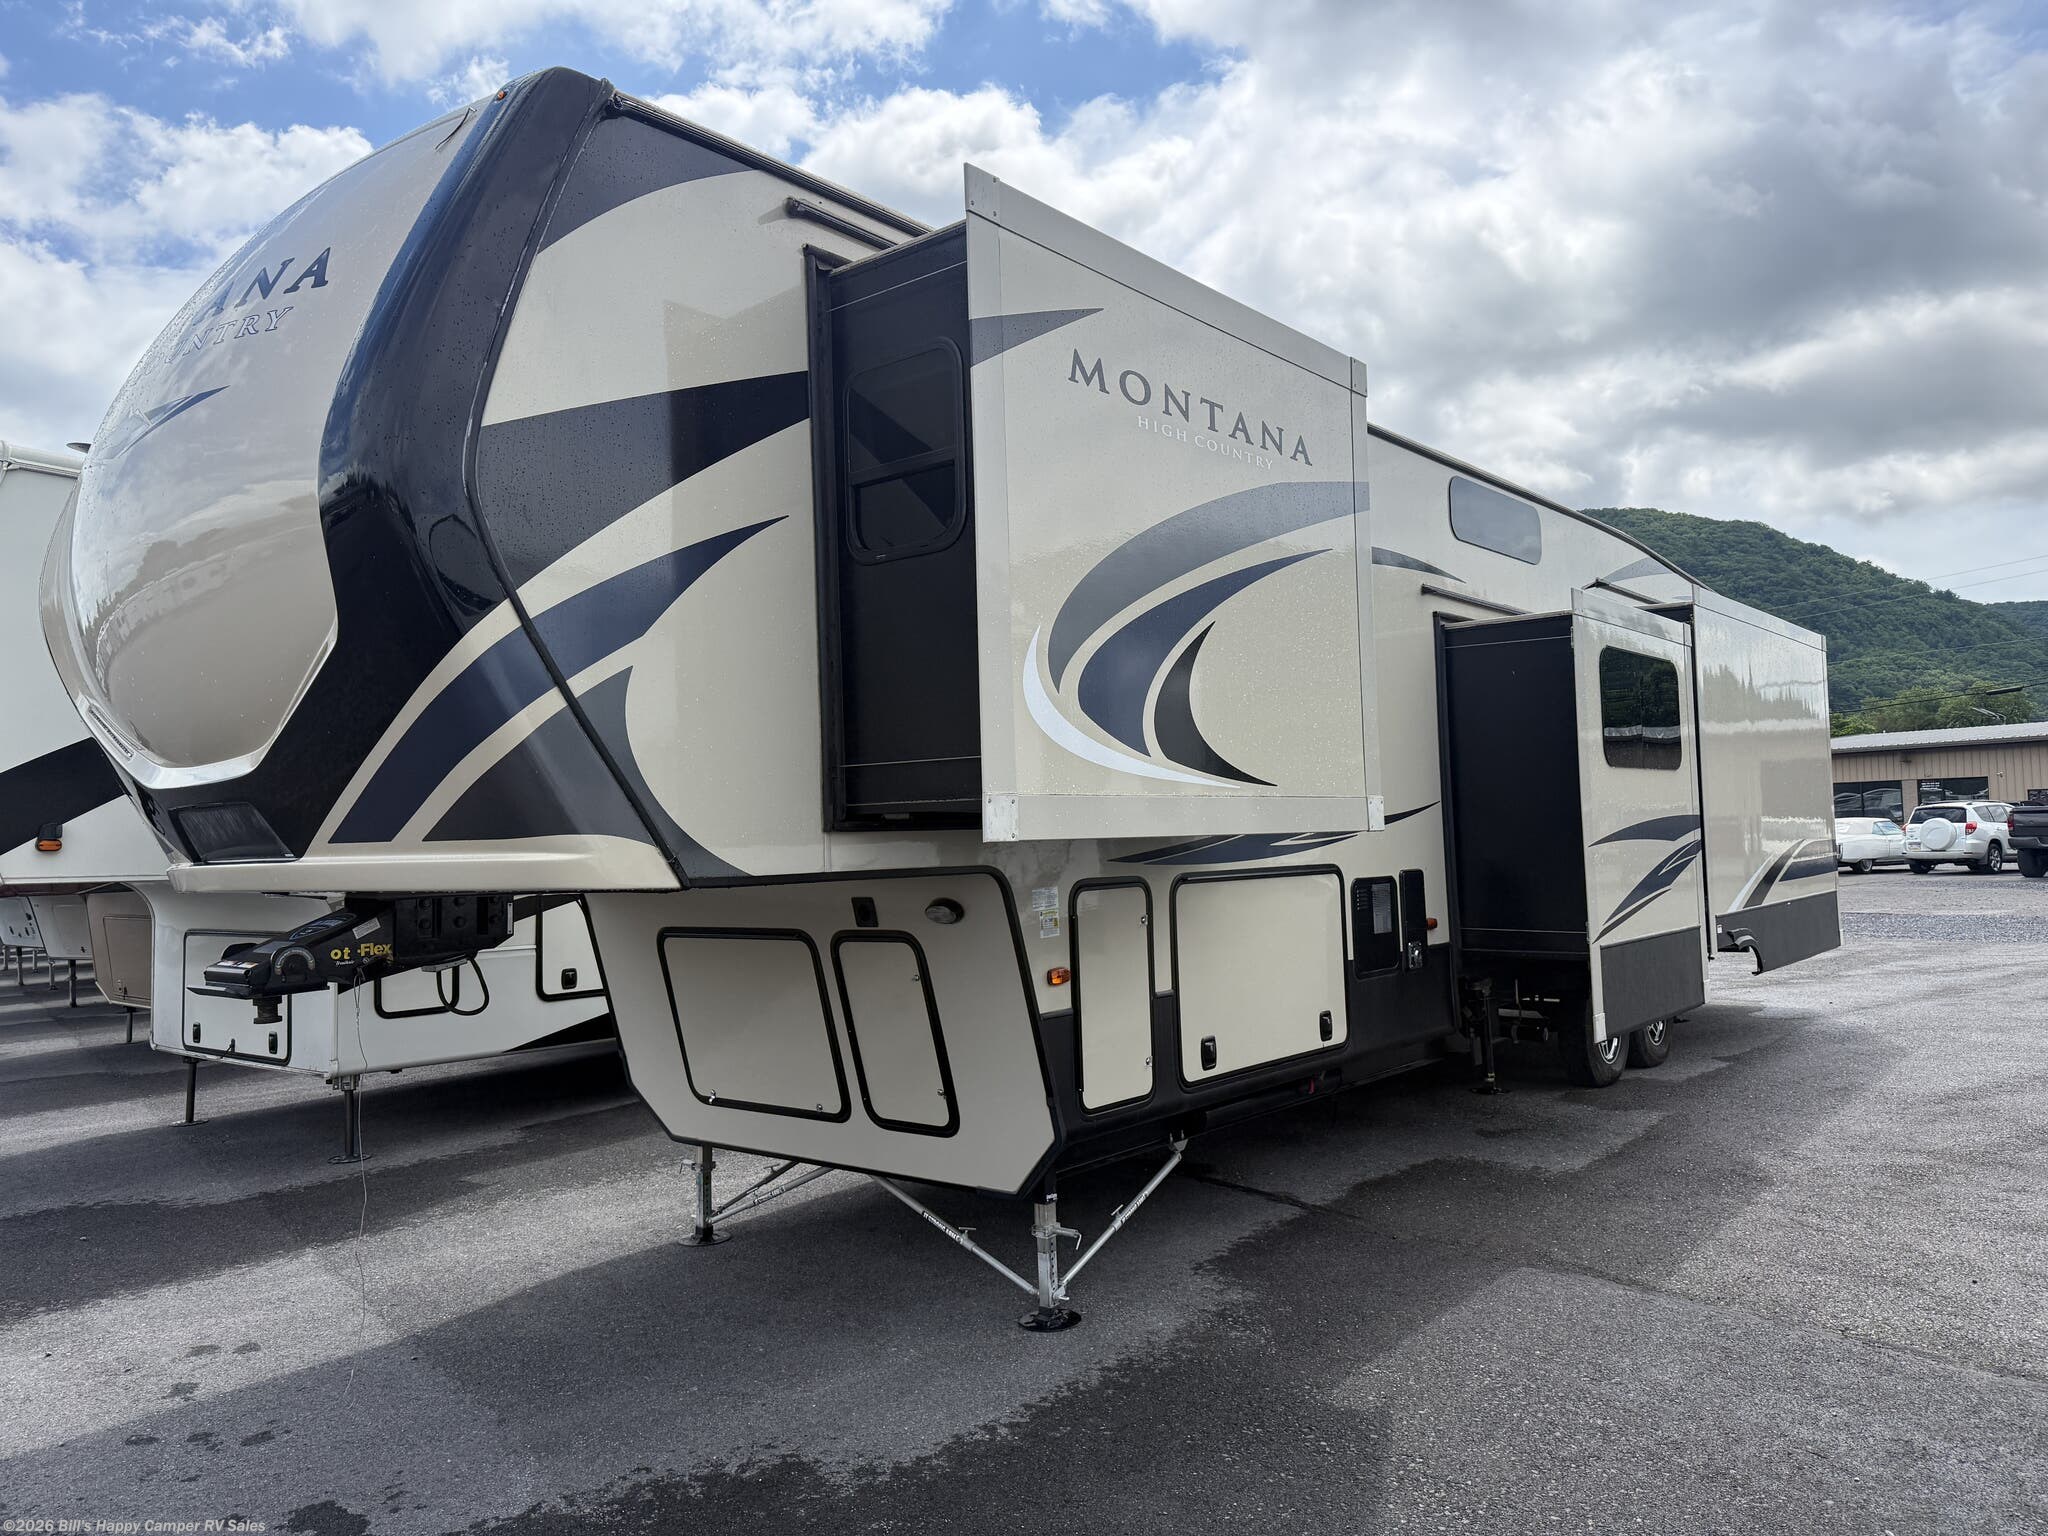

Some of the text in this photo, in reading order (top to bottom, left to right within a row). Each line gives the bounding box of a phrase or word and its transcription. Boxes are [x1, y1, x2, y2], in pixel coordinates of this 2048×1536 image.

[1068, 348, 1313, 466] MONTANA
[1138, 415, 1274, 470] HIGH COUNTRY
